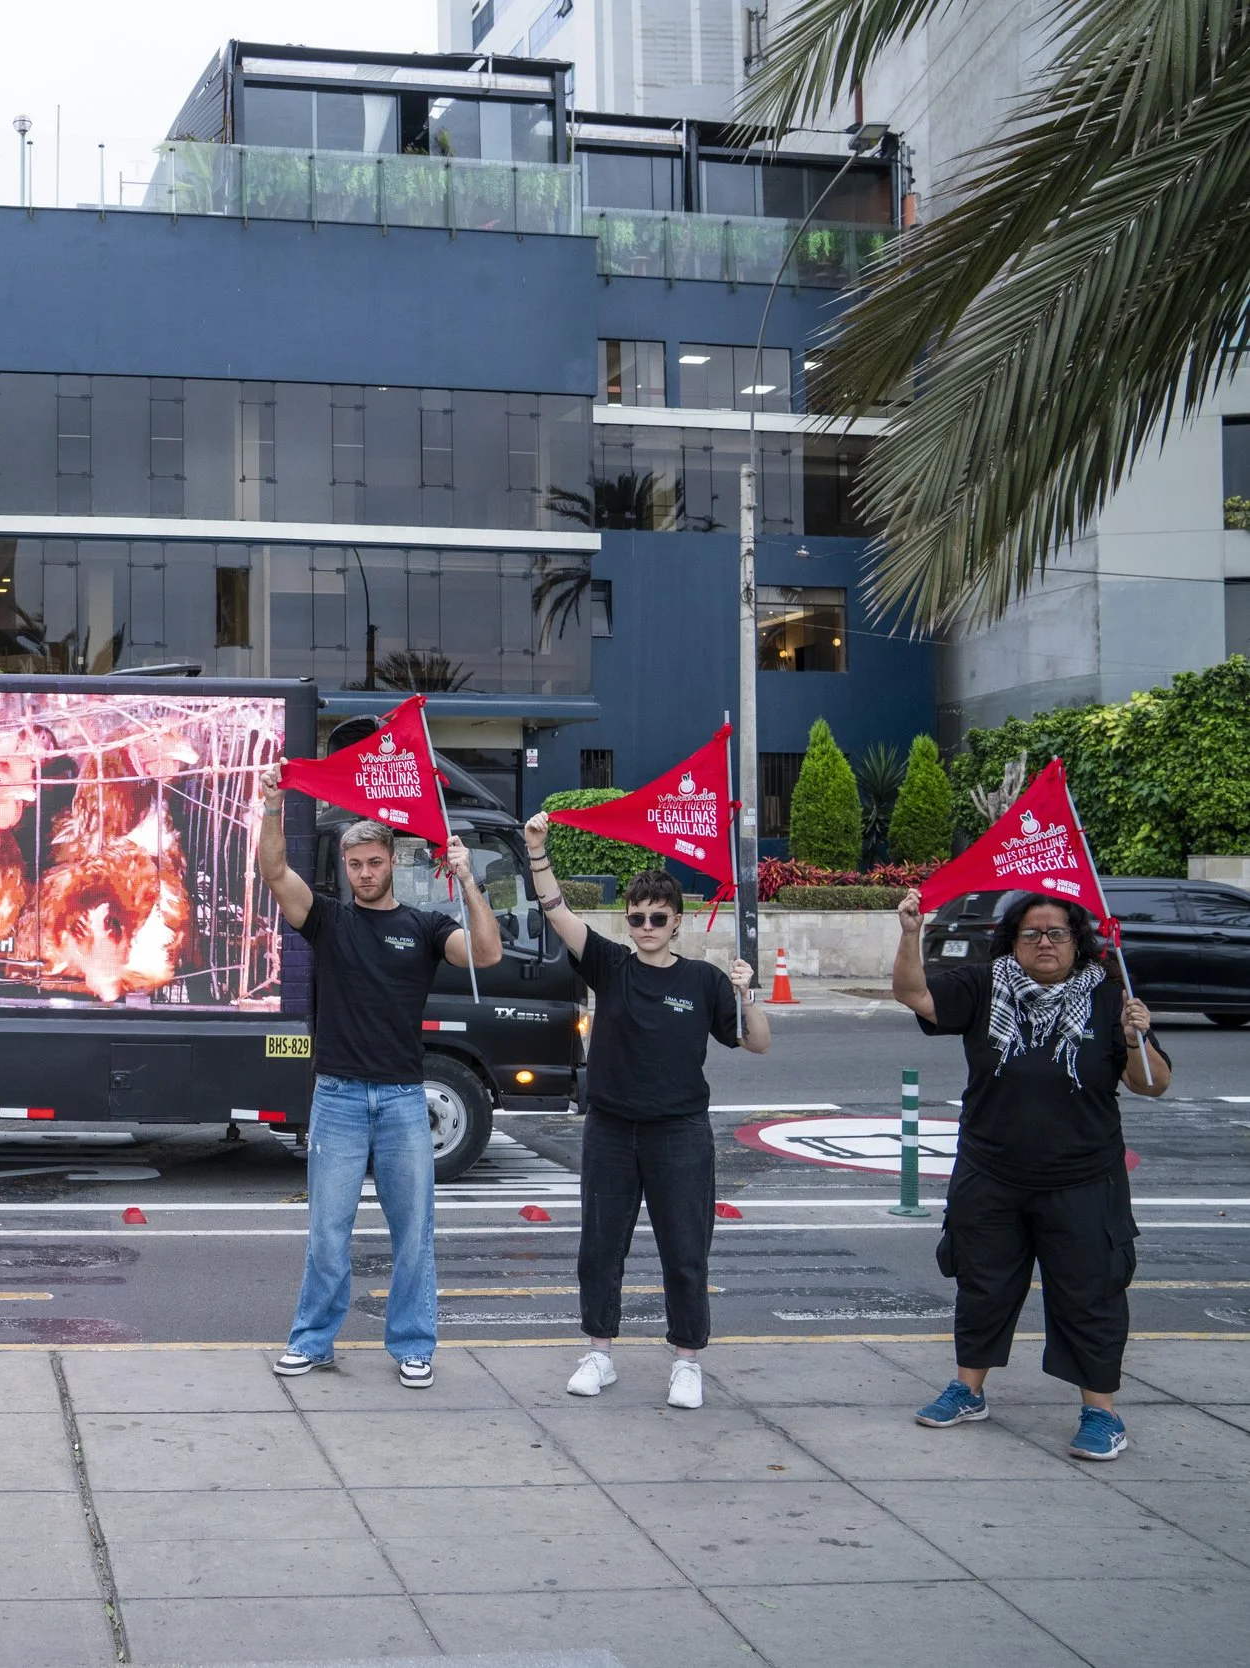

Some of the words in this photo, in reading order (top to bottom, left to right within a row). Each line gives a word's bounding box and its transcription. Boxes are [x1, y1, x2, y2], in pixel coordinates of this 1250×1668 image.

[358, 748, 415, 763] Vivanda
[361, 762, 386, 773] VENDE
[387, 760, 417, 772] HUEVOS
[355, 772, 369, 787] DE
[371, 771, 420, 786] GALLINAS
[365, 785, 422, 799] ENJAULADAS
[657, 788, 716, 802] Vivanda
[658, 801, 683, 810] VENDE
[684, 801, 717, 811] HUEVOS
[647, 809, 661, 822] DE
[664, 810, 717, 825] GALLINAS
[657, 822, 718, 838] ENJAULADAS
[1001, 823, 1067, 850] Vivanda
[992, 850, 1018, 866] MILES
[1018, 846, 1029, 858] DE
[1029, 834, 1068, 855] GALLINAS
[1056, 885, 1080, 897] ANIMAL
[268, 1037, 309, 1055] BHS-829
